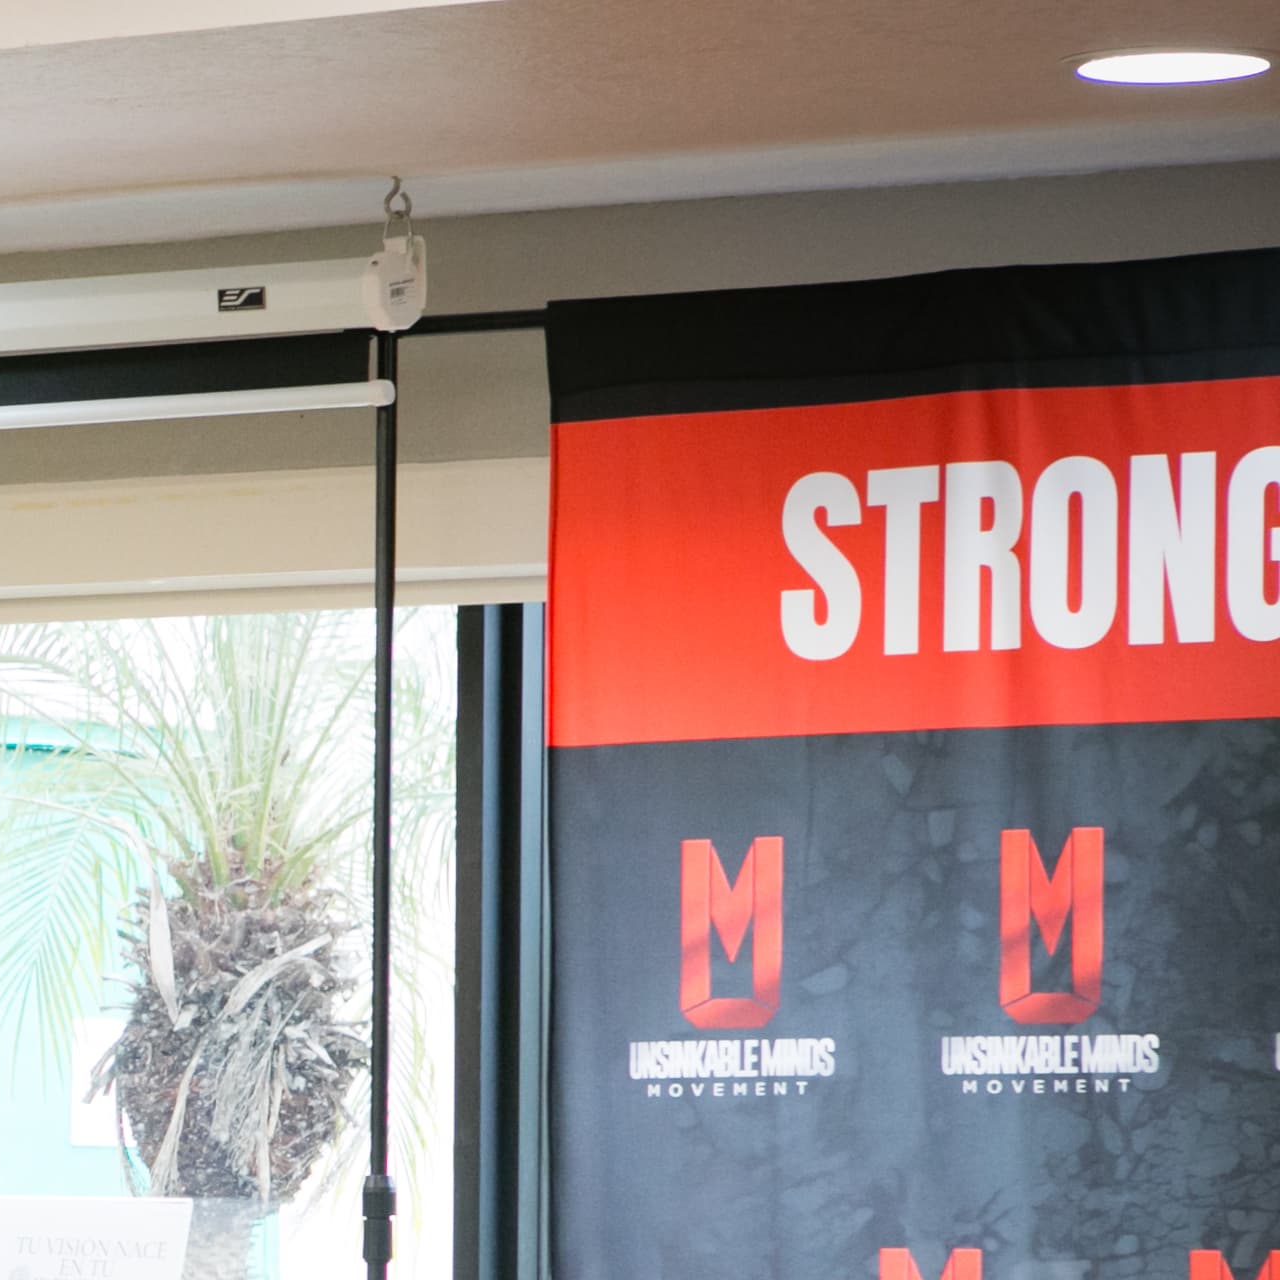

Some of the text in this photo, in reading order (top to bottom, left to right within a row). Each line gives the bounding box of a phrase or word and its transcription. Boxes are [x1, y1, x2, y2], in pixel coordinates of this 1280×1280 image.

[780, 446, 1280, 661] STRONG
[629, 1038, 836, 1079] UNSINKABLE MINDS
[941, 1033, 1160, 1075] UNSINKABLE MINDS
[647, 1081, 808, 1098] MOVEMENT
[962, 1078, 1131, 1095] MOVEMENT
[16, 1235, 39, 1255] TU
[116, 1240, 168, 1260] NACE
[58, 1257, 116, 1278] EN TU
